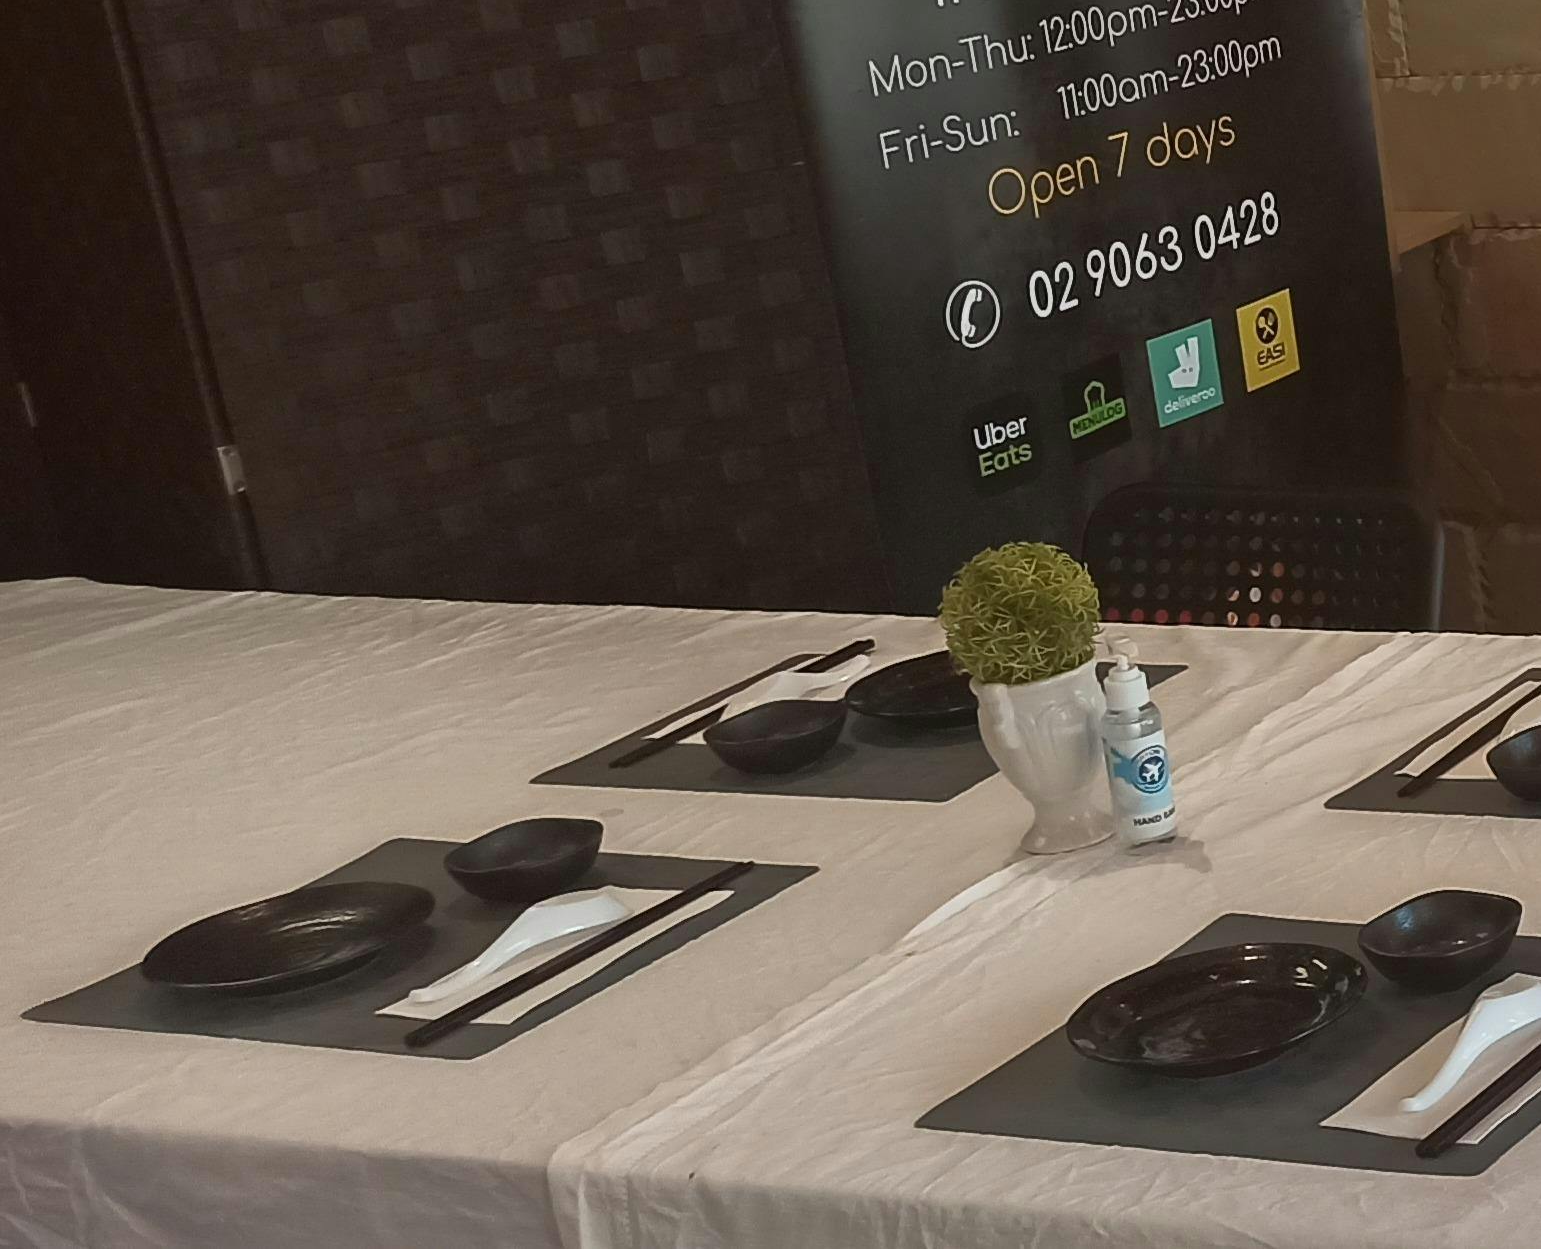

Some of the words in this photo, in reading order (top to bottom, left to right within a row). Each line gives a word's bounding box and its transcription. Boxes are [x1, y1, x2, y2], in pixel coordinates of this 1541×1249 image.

[869, 35, 1034, 96] Mon-Thu:
[880, 111, 1019, 169] Fri-Sun:
[1057, 38, 1281, 119] 11:00am-23:00pm
[989, 157, 1099, 218] Open
[1108, 132, 1128, 177] 7
[1147, 116, 1235, 166] days
[1029, 262, 1078, 317] 02
[1087, 226, 1182, 296] 9063
[1195, 192, 1278, 259] 0428
[1257, 344, 1286, 366] EASI
[974, 417, 1027, 449] Uber
[979, 444, 1032, 476] Eats
